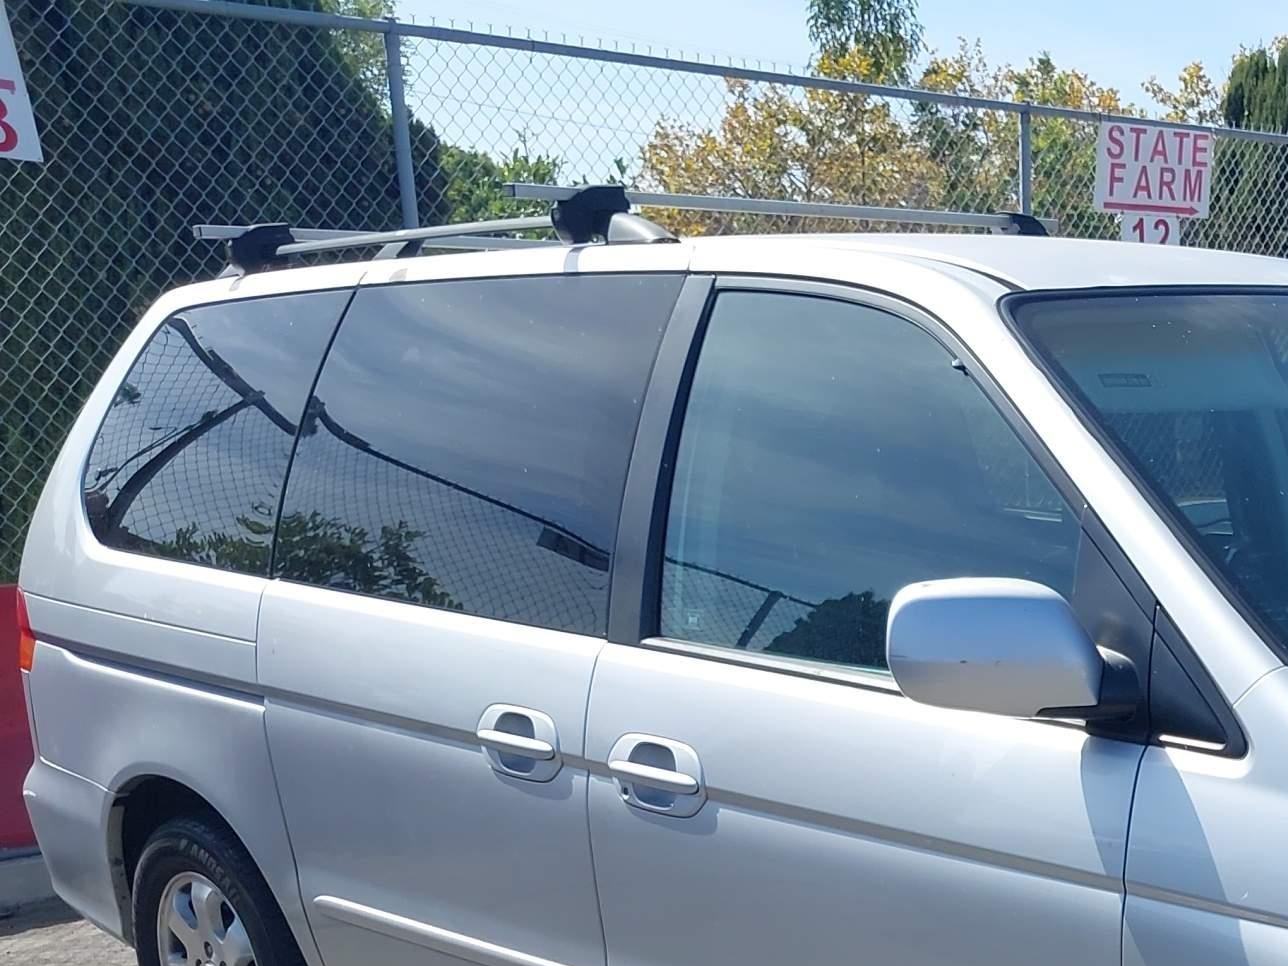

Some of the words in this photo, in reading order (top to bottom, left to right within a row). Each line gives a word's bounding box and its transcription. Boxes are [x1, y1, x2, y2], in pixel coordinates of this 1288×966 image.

[1106, 124, 1210, 168] STATE
[1108, 162, 1204, 203] FARM
[1132, 217, 1170, 245] 12
